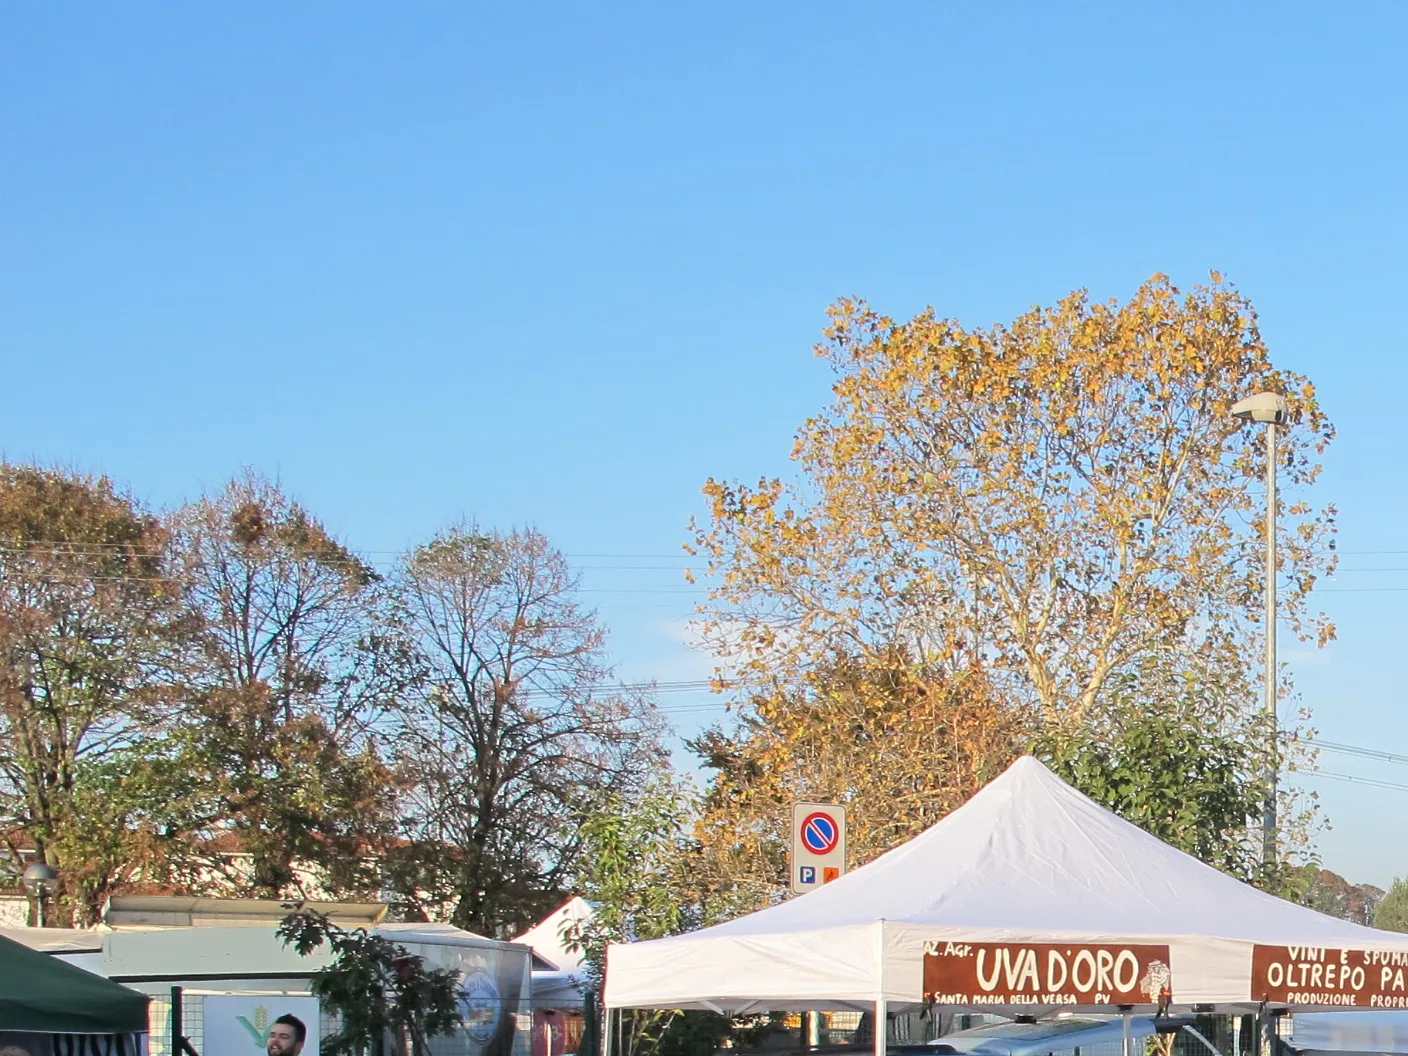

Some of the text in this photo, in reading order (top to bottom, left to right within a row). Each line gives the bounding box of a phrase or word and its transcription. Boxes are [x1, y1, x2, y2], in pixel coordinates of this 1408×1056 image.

[944, 941, 974, 957] Agr.
[1287, 946, 1326, 963] VINI
[1340, 949, 1349, 965] E
[976, 948, 1139, 993] UVA D'ORO
[1267, 962, 1365, 991] OLTREPO
[934, 991, 1111, 1005] SANTA MARIA DELLA VERSA PV
[1287, 992, 1356, 1006] PRODUZIONE
